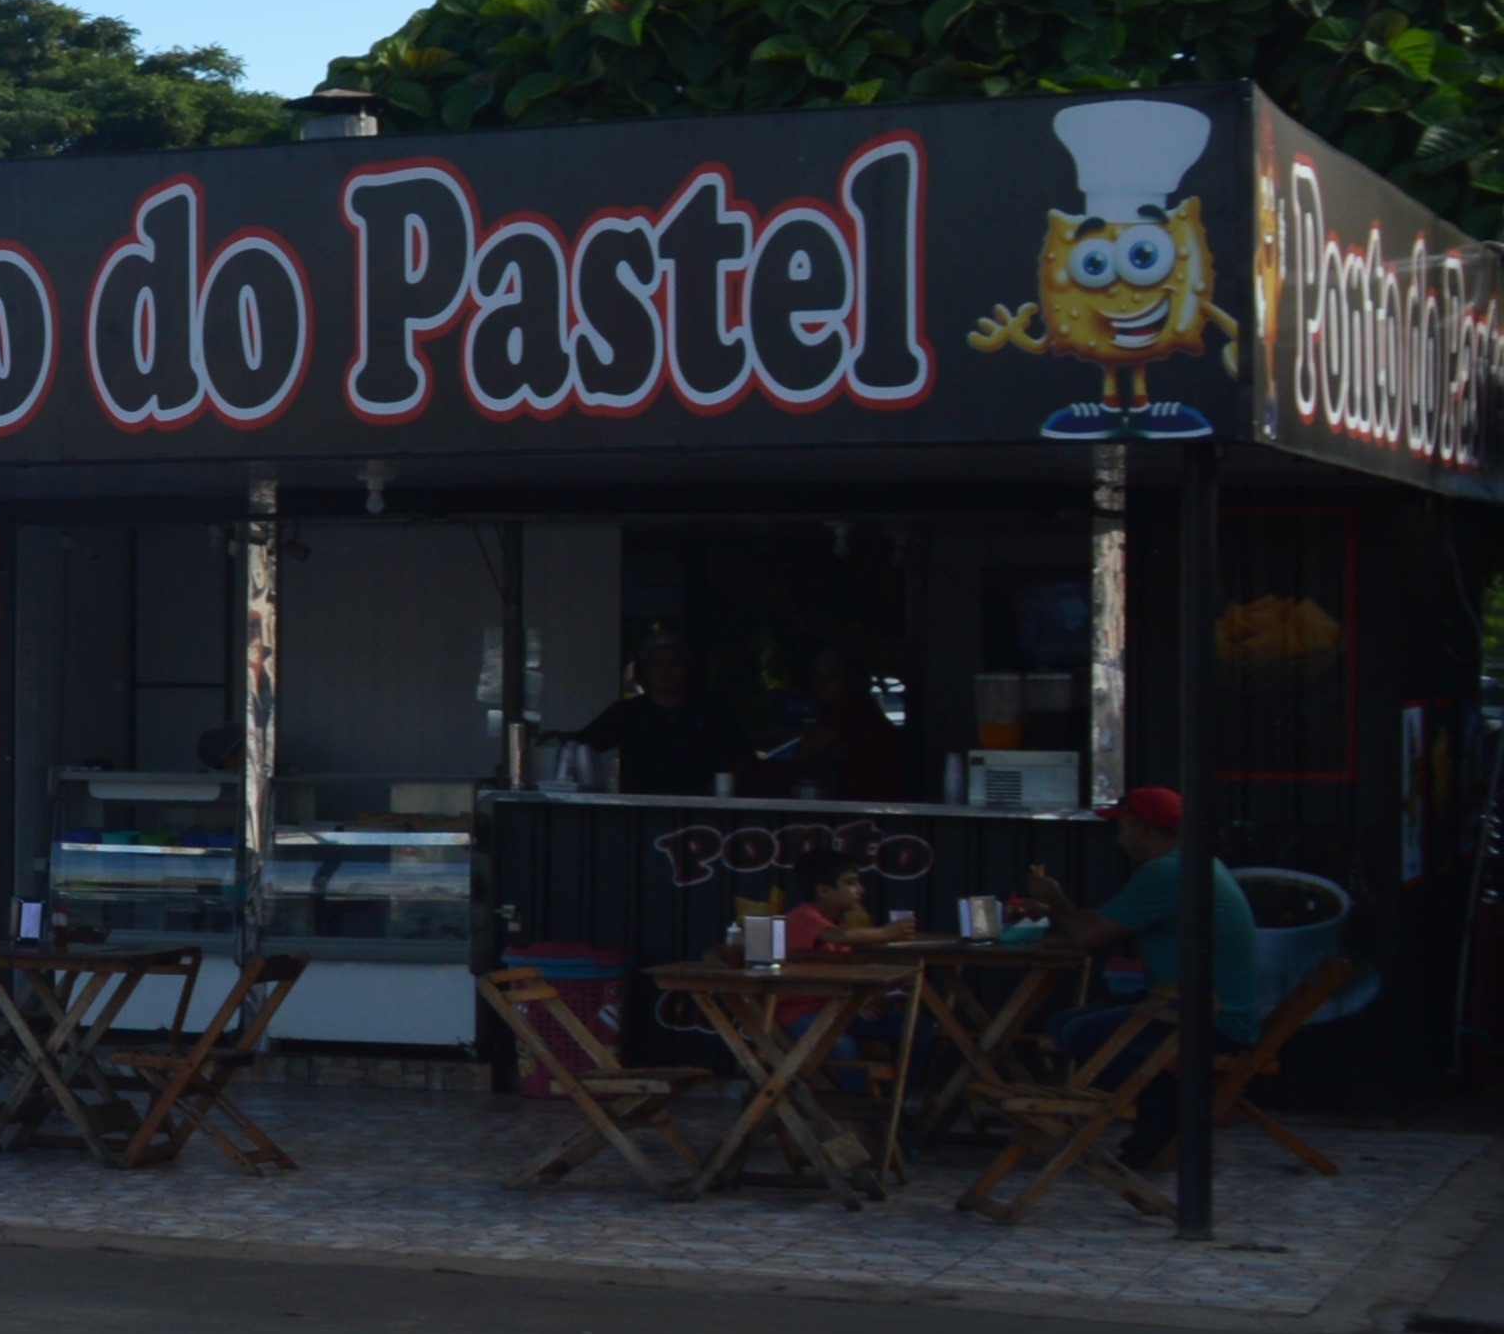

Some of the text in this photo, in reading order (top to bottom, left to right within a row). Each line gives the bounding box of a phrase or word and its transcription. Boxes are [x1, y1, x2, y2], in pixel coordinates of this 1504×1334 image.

[85, 173, 312, 433] do
[339, 128, 935, 425] Pastel
[1291, 152, 1403, 452] Ponto
[1405, 230, 1439, 455] do
